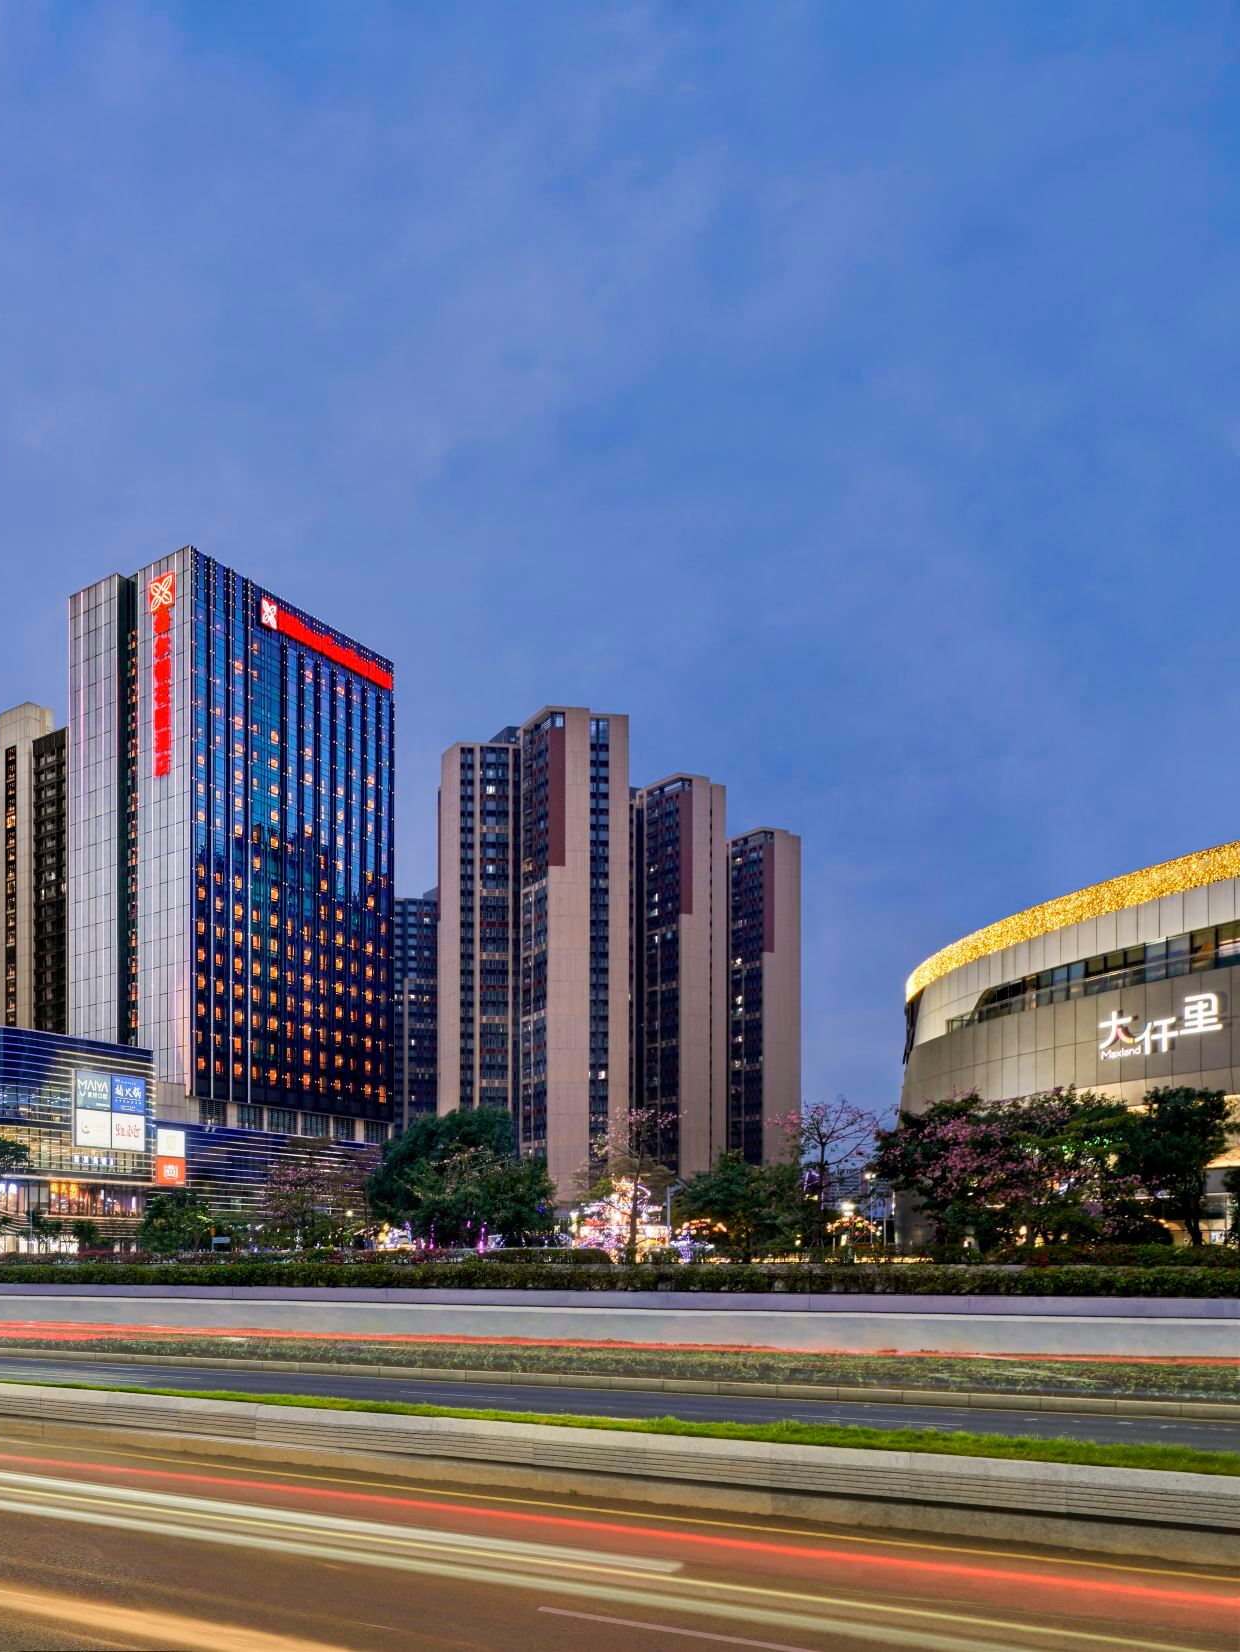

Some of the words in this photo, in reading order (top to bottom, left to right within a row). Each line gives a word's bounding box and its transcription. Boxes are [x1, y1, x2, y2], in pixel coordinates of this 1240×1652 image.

[1100, 993, 1223, 1055] 大仟里
[1101, 1045, 1142, 1060] Maxland
[77, 1078, 108, 1093] MAIYA
